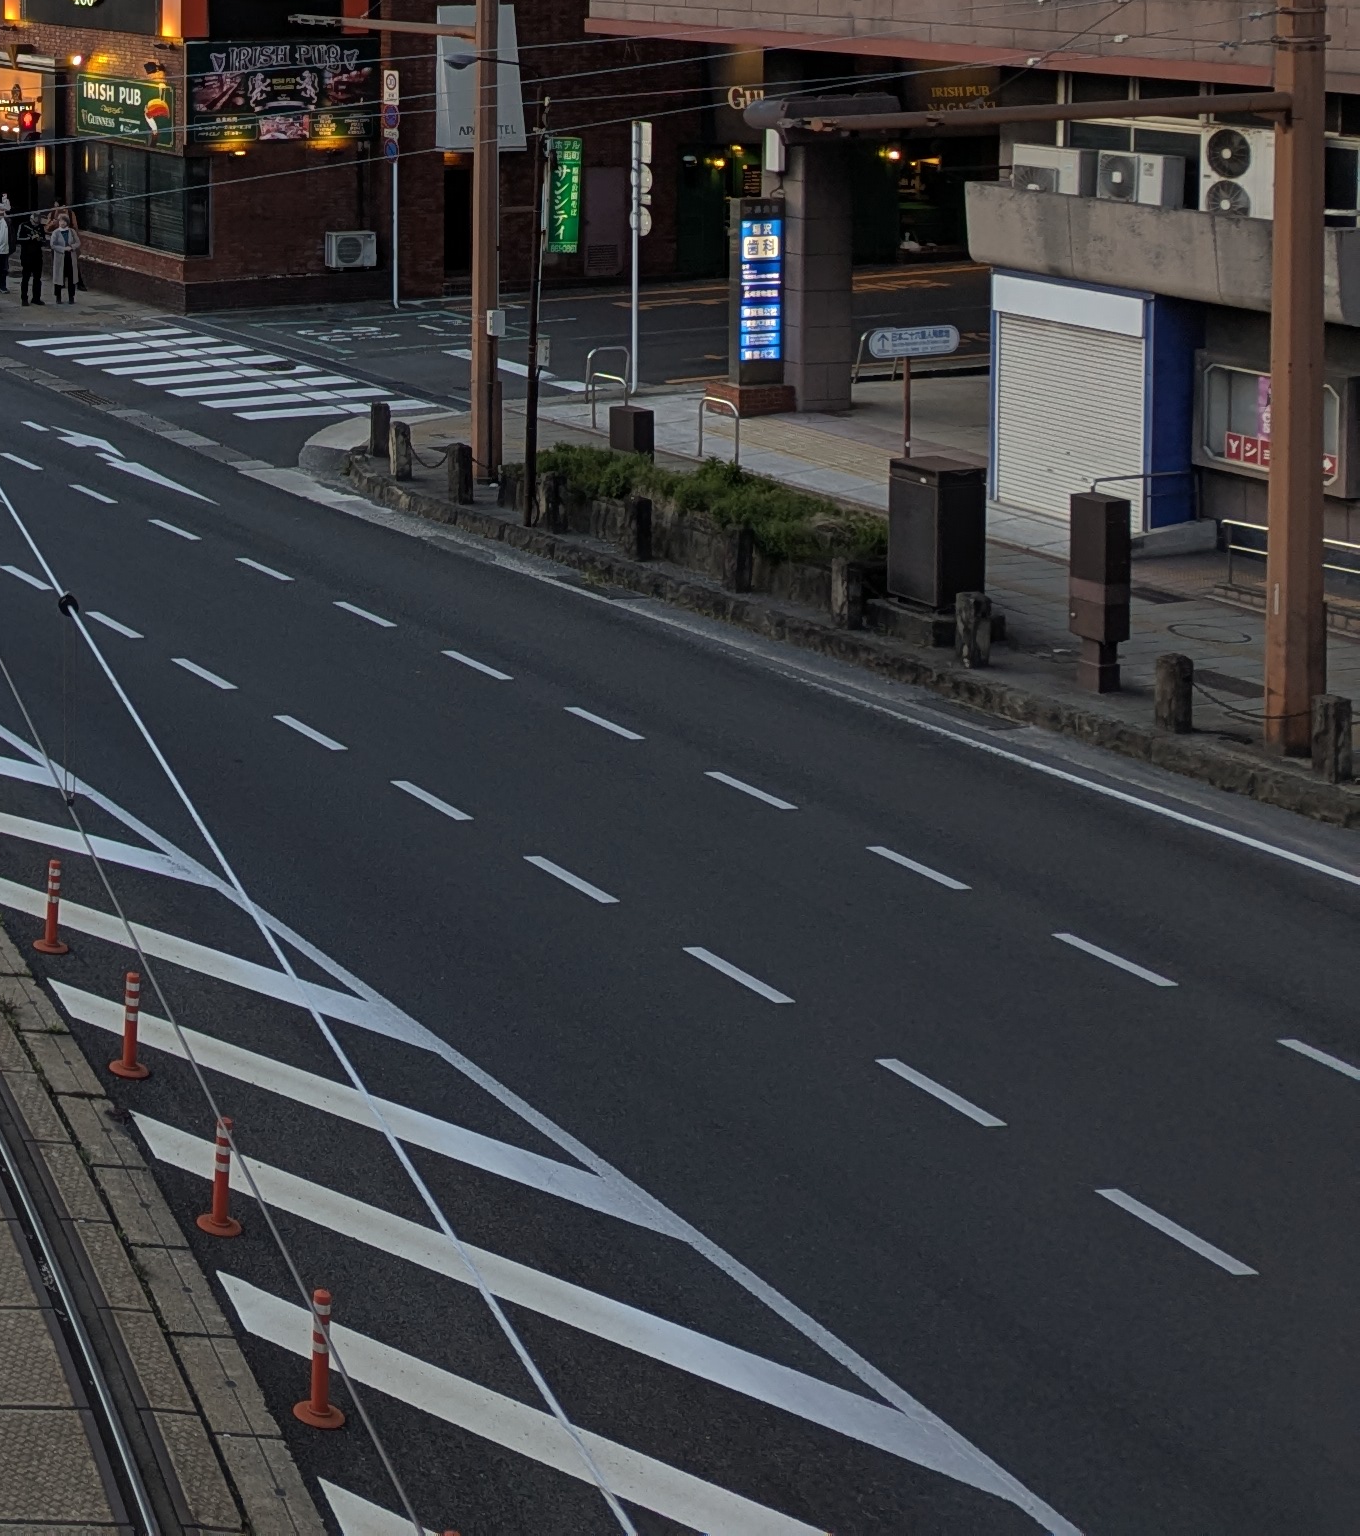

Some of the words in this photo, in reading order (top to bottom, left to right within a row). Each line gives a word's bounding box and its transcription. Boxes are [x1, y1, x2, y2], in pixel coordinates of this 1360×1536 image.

[228, 45, 292, 73] IRISH
[294, 44, 342, 74] PUB
[83, 81, 115, 103] IRISH
[118, 86, 142, 106] PUB
[931, 85, 964, 98] IRISH
[965, 85, 990, 97] PUB
[927, 100, 996, 112] NAGAKI
[747, 238, 775, 256] 歯科
